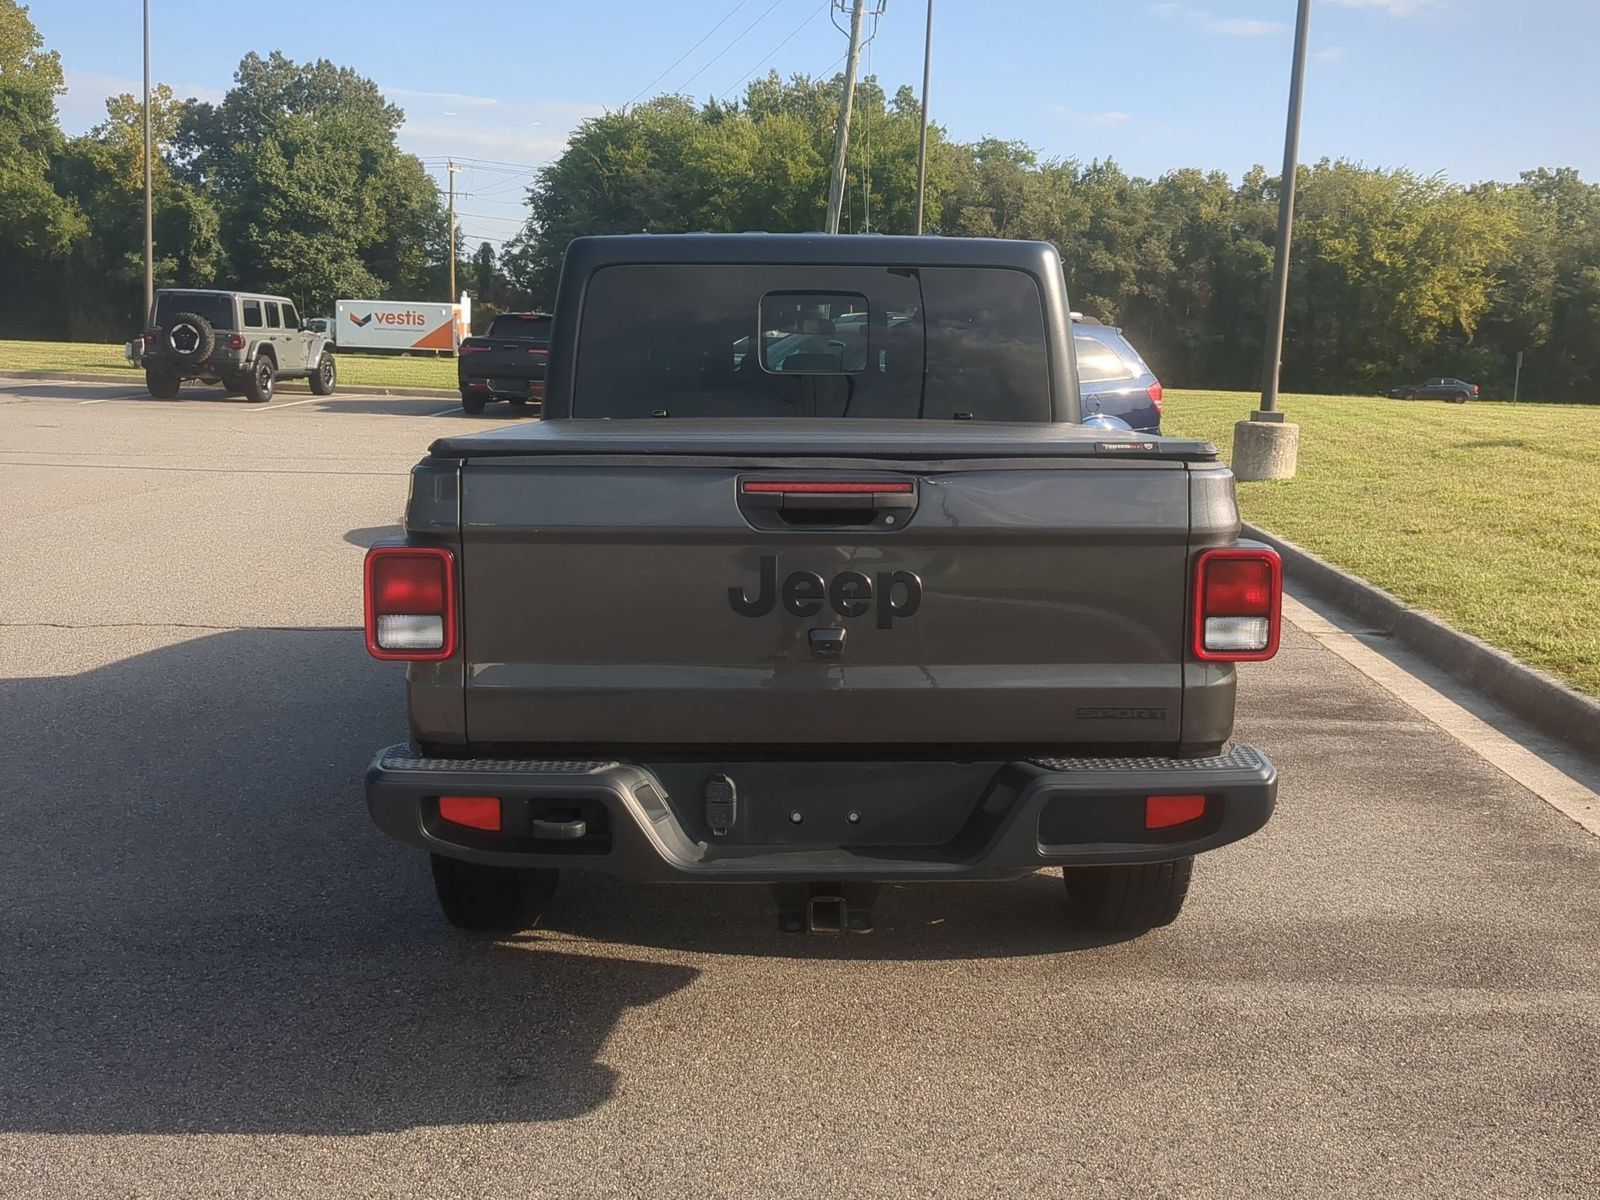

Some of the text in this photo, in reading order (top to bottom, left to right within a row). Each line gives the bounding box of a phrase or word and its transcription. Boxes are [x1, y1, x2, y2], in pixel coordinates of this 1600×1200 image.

[374, 310, 425, 326] vestis
[728, 555, 923, 630] Jeep
[1076, 707, 1167, 720] SPORT
